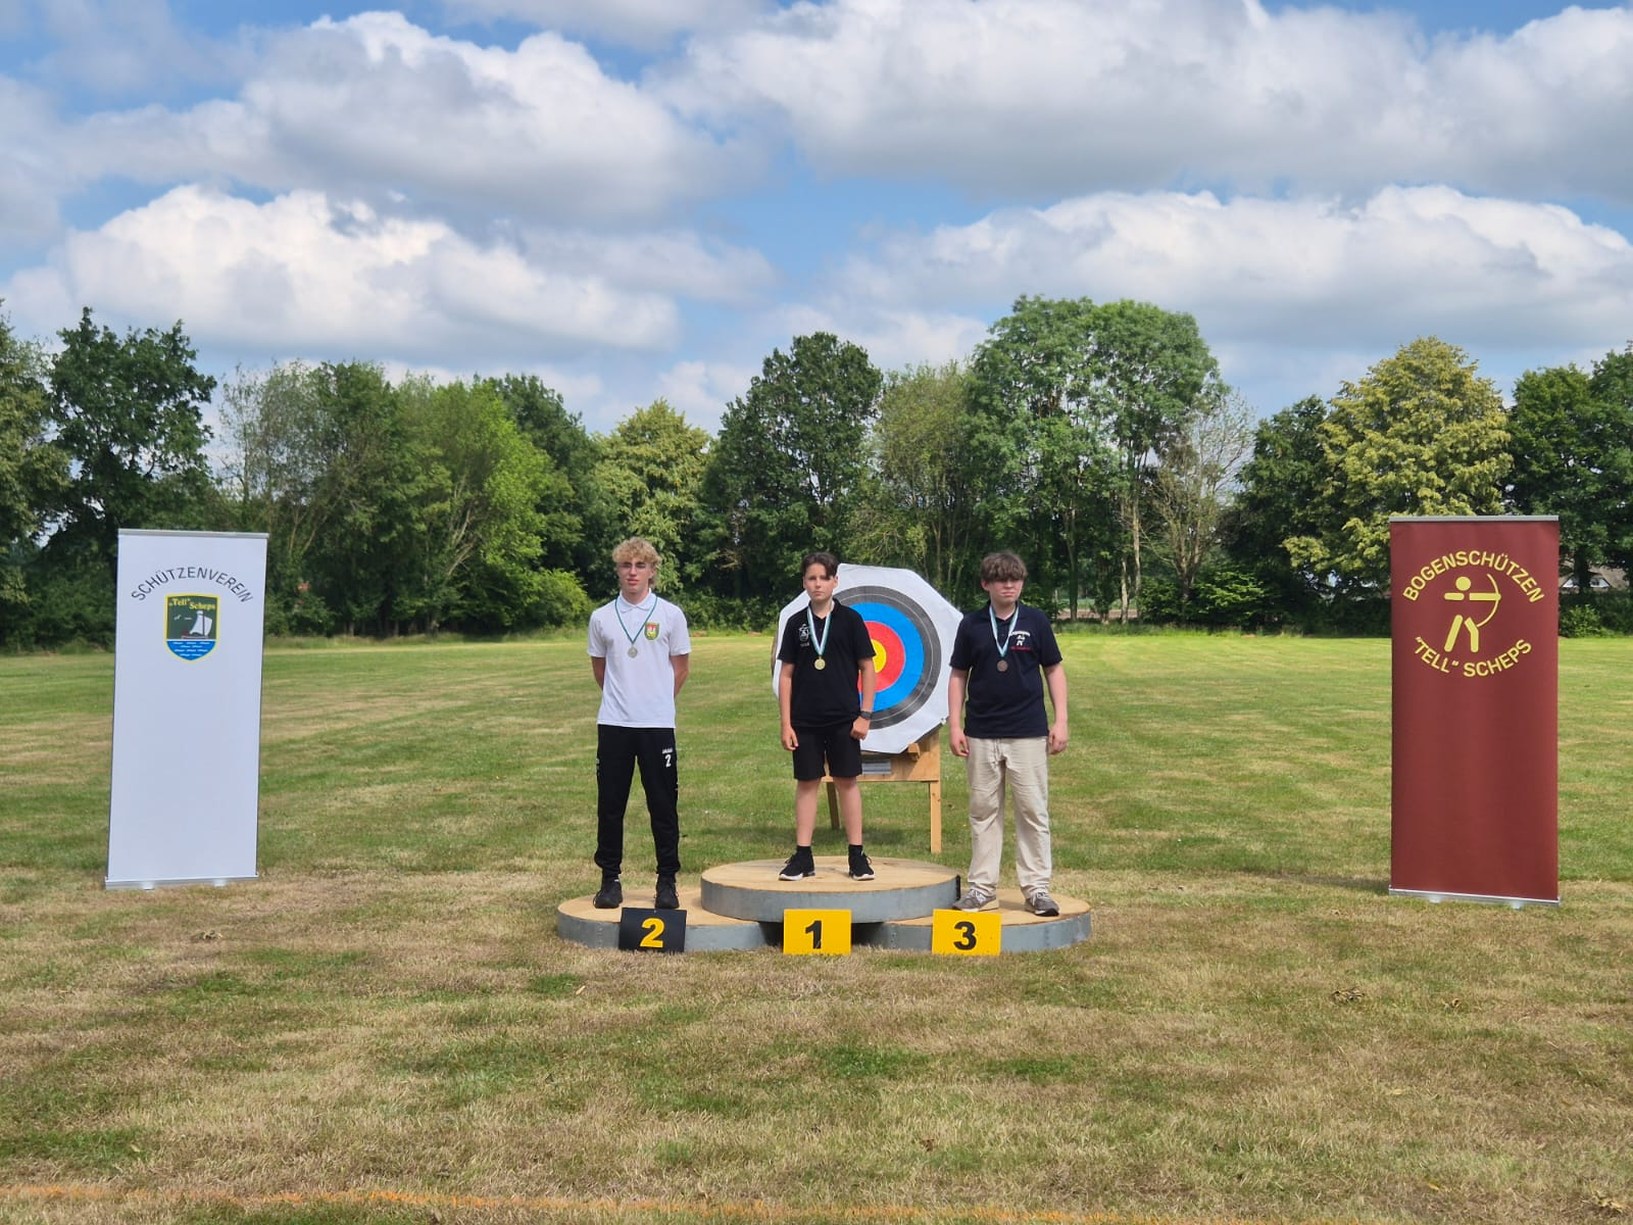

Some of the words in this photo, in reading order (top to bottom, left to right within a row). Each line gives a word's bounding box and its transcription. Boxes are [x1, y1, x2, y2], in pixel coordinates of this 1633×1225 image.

[131, 566, 253, 603] SCHÜTZENVEREIN
[1403, 550, 1545, 602] BOGENSCHÜTZEN
[1463, 639, 1532, 677] SCHEPS
[639, 917, 665, 948] 2
[804, 920, 823, 950] 1
[953, 921, 976, 951] 3
